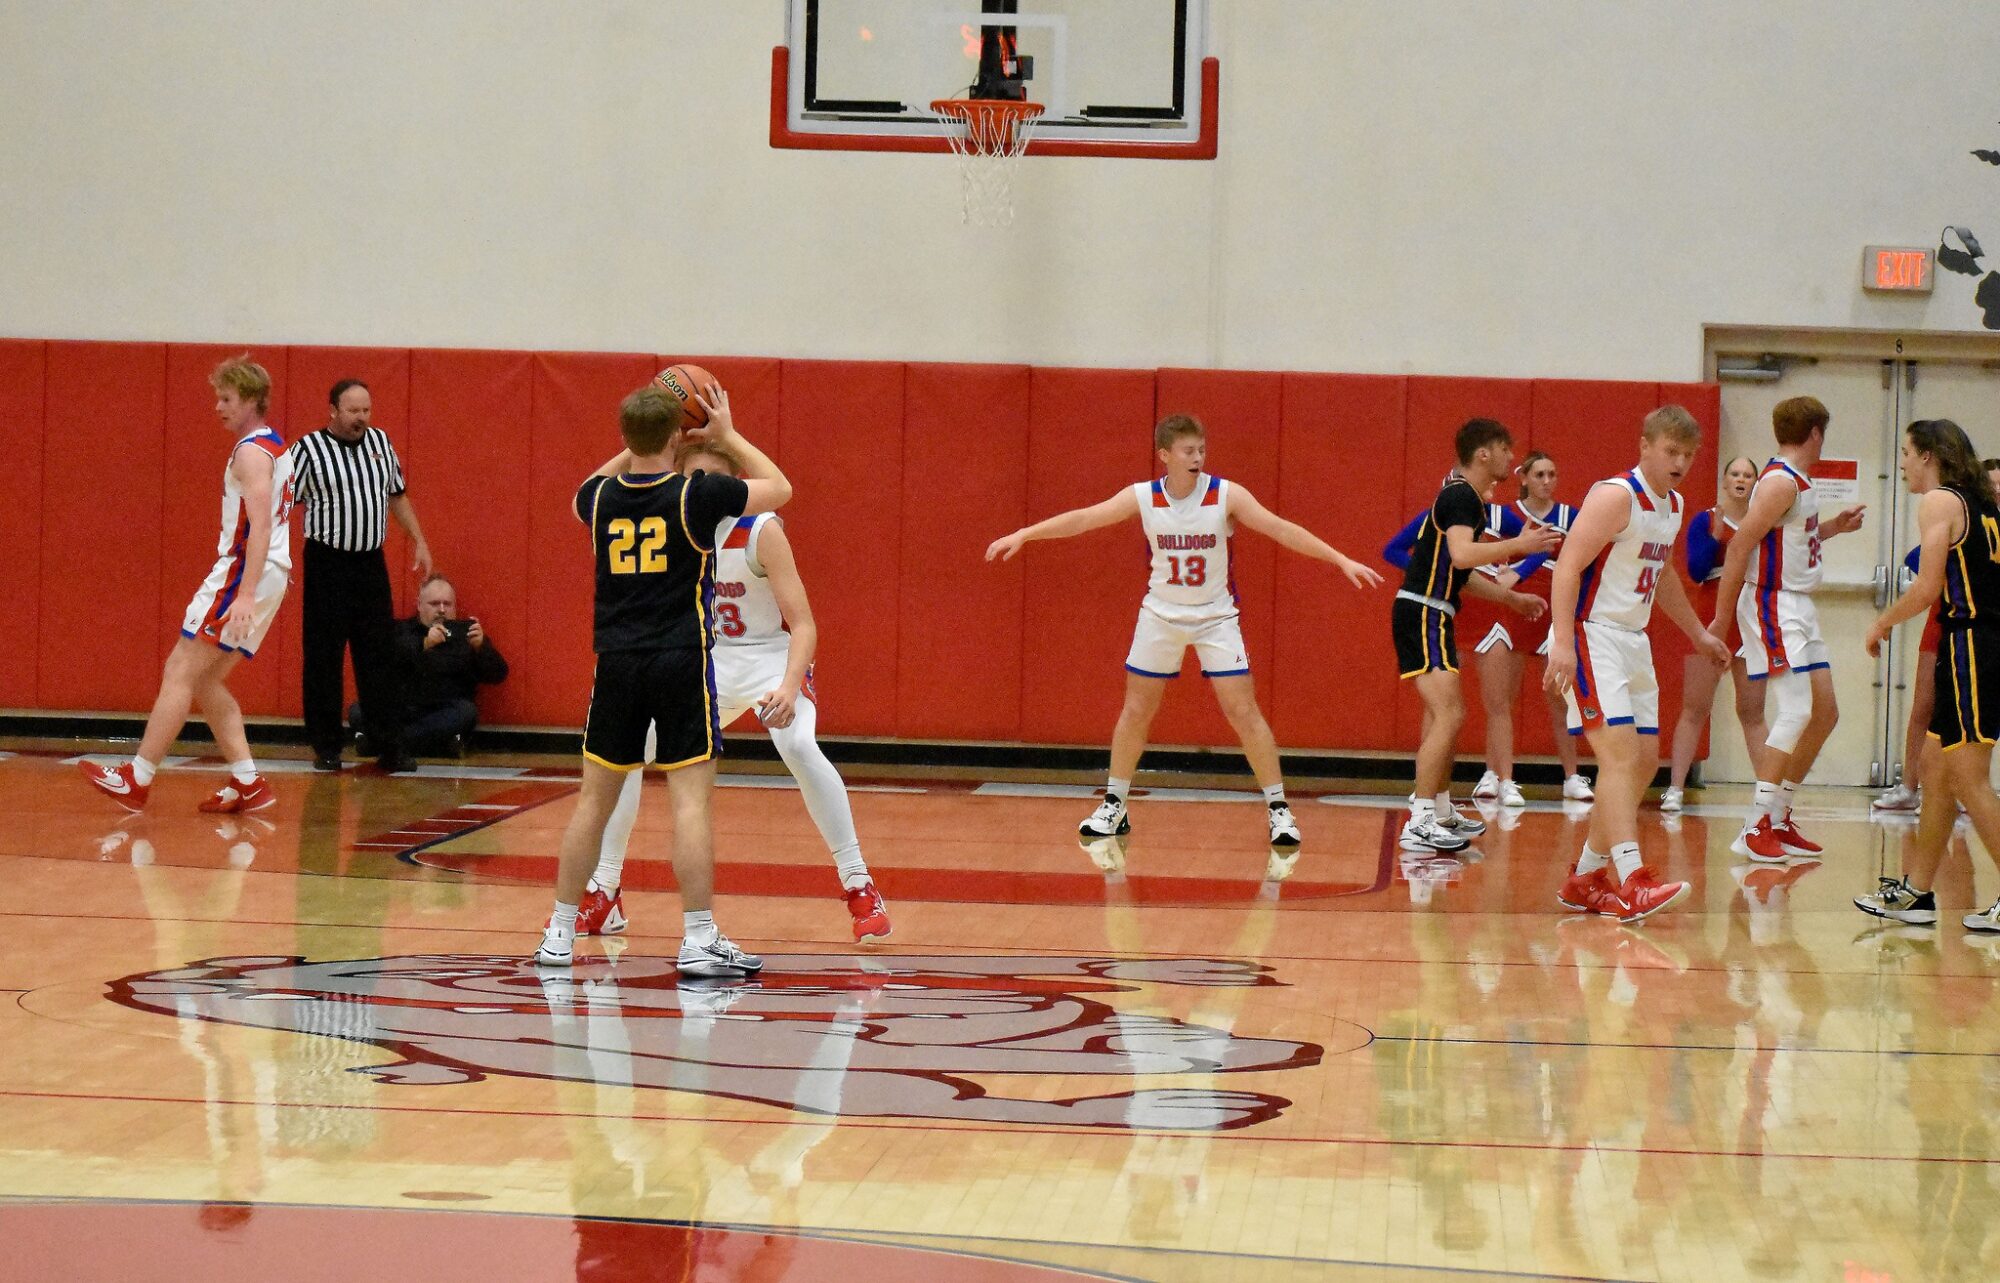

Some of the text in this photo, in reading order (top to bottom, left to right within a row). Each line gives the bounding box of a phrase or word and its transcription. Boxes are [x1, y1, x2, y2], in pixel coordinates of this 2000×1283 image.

[1876, 251, 1926, 288] EXIT
[1895, 338, 1904, 355] 8
[660, 369, 689, 402] ilson
[608, 516, 667, 575] 22
[1156, 533, 1217, 551] BULLDOGS
[1166, 554, 1207, 588] 13
[714, 602, 748, 639] 3
